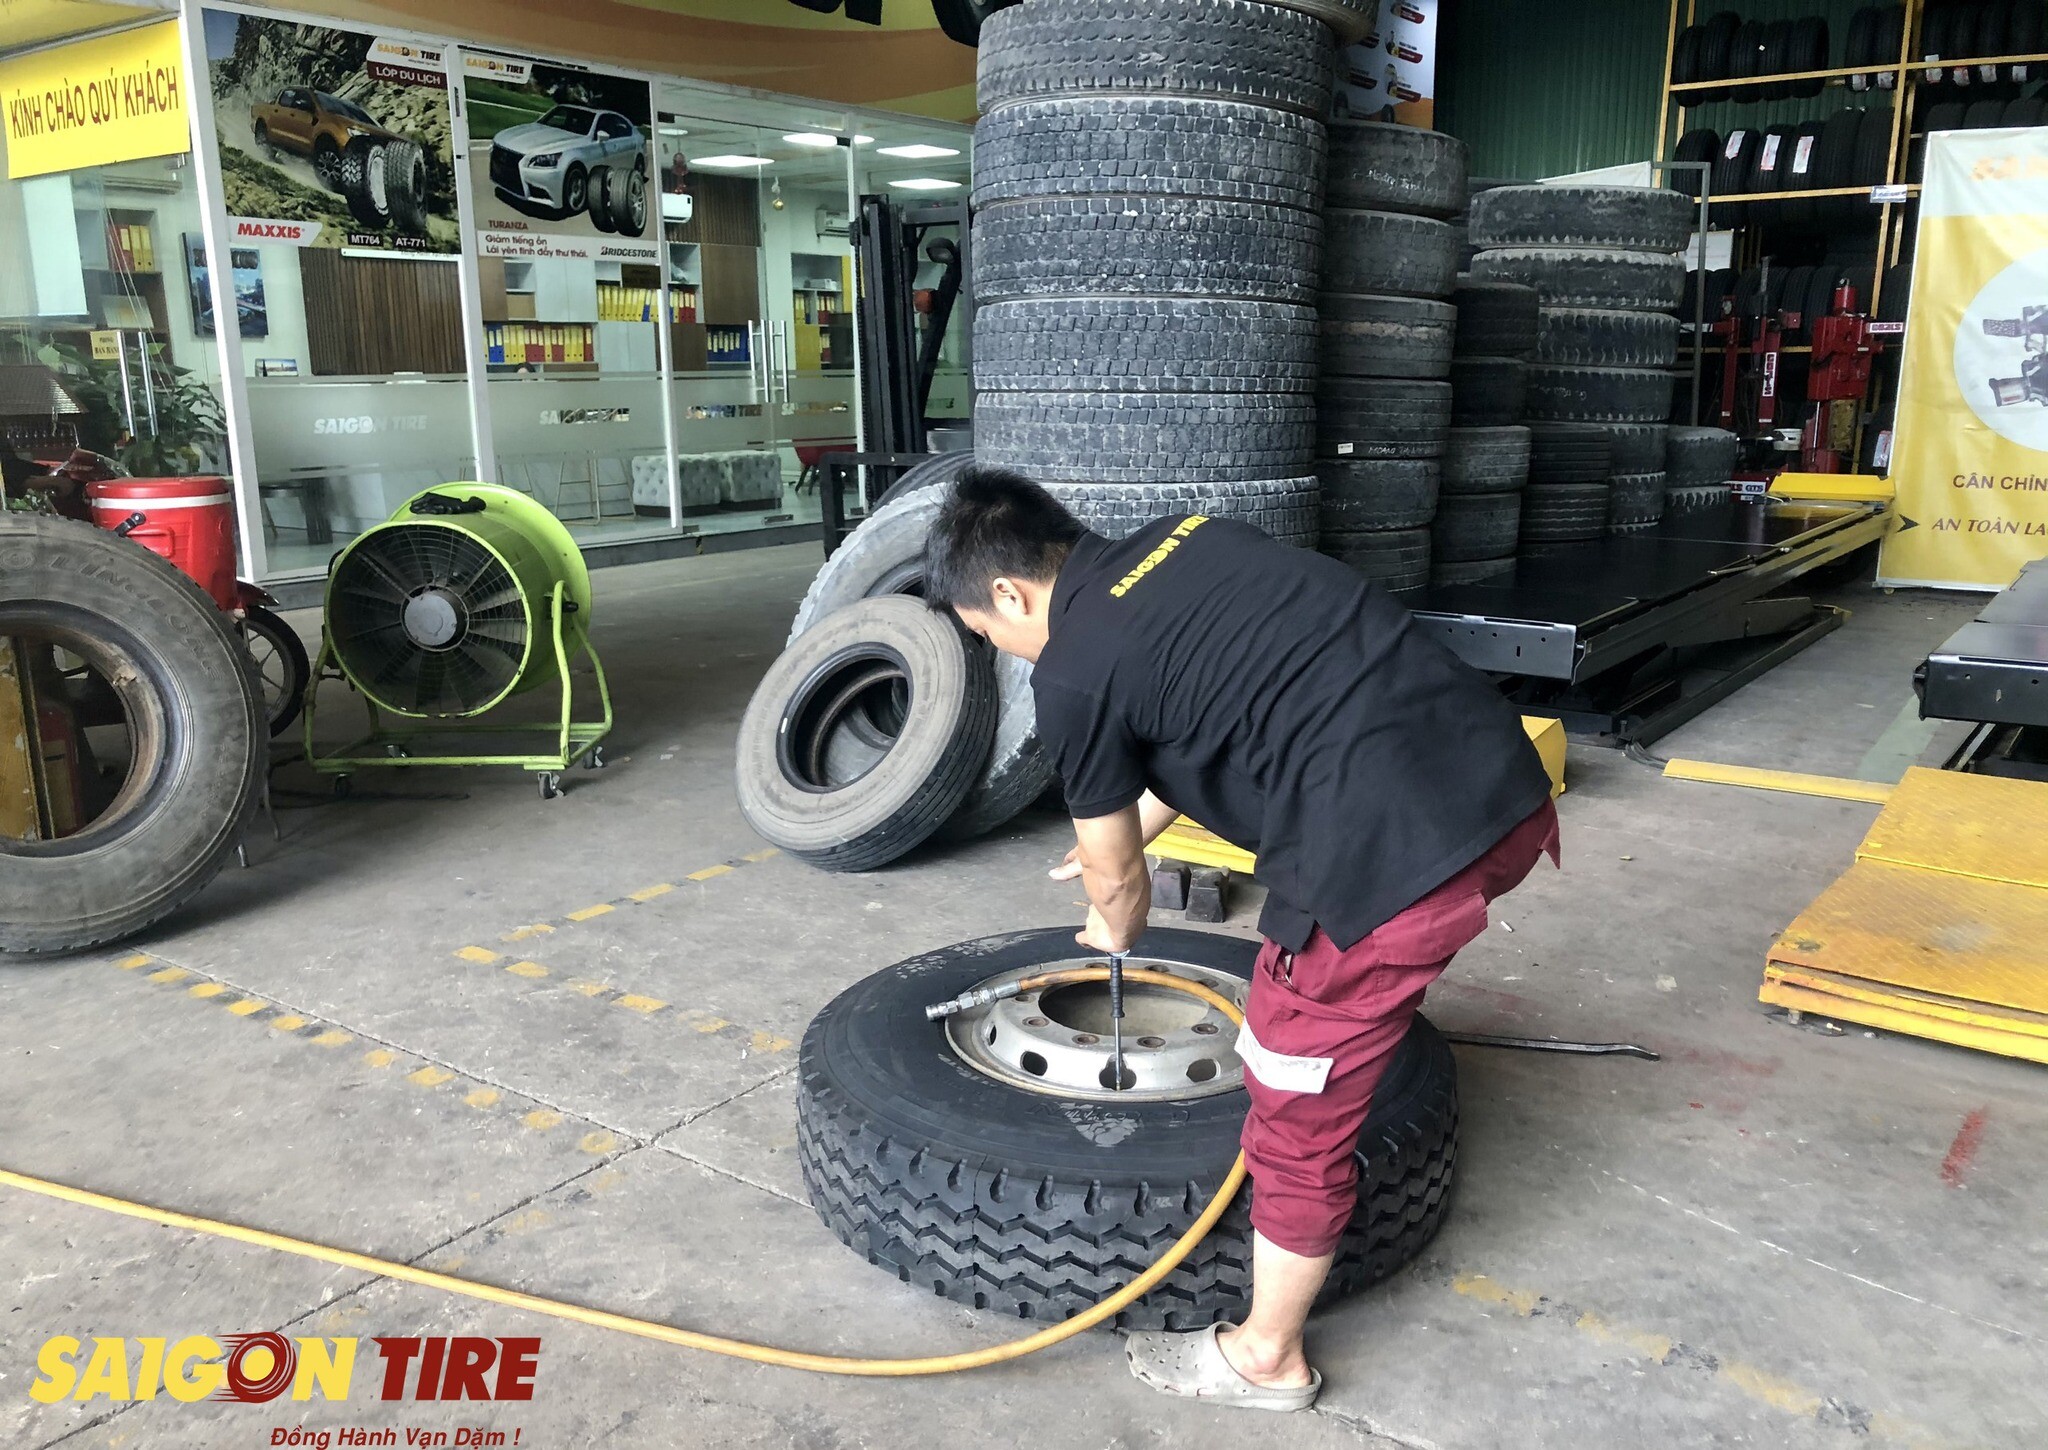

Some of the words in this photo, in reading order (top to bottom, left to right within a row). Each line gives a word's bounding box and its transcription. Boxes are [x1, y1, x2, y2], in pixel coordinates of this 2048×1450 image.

[420, 50, 441, 61] TIRE
[400, 70, 415, 80] DU
[506, 64, 525, 74] TIRE
[10, 89, 43, 138] KÍNH
[46, 78, 86, 132] CHÀO
[89, 67, 118, 125] QUÝ
[123, 60, 179, 118] KHÁCH
[238, 223, 301, 239] MAXXIS
[488, 220, 528, 230] TURANZA
[351, 234, 380, 245] MT764
[396, 237, 426, 247] AT-771
[485, 234, 510, 243] Giảm
[512, 235, 534, 246] tiếng
[486, 245, 499, 254] Lái
[501, 246, 517, 255] yên
[601, 246, 657, 258] BRIDGESTONE
[313, 415, 388, 434] SAIGON
[391, 415, 428, 430] TIRE
[1953, 471, 1994, 489] CÂN
[1931, 518, 1961, 531] AN
[1967, 517, 2019, 534] TOÀN
[2024, 523, 2048, 535] LA
[1110, 537, 1181, 598] SAIGON
